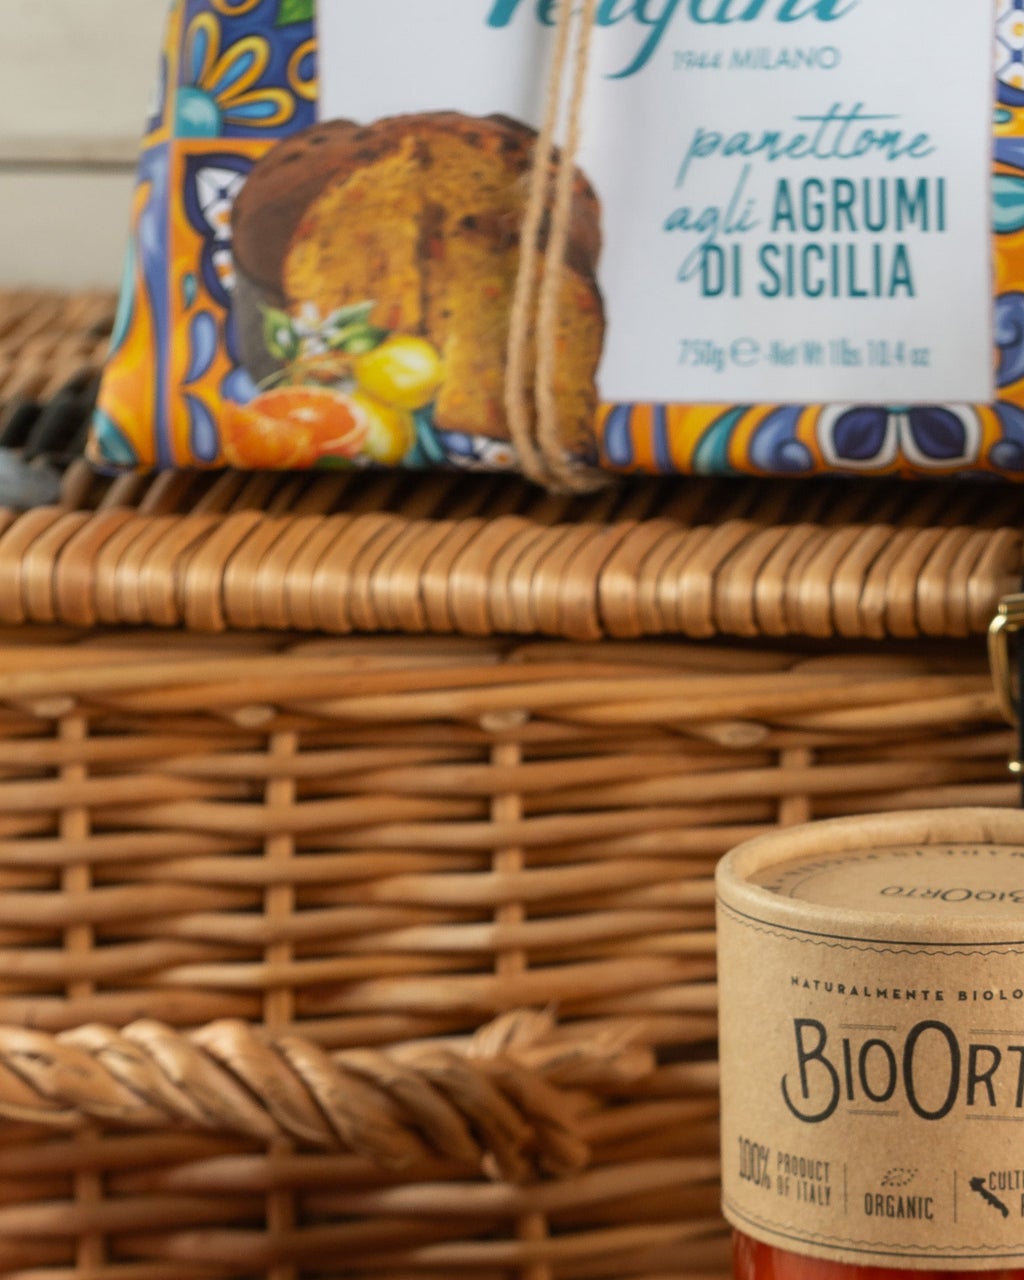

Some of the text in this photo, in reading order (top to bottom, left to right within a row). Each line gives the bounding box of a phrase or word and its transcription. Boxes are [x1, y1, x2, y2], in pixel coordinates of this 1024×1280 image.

[727, 47, 841, 70] MILANO
[674, 103, 937, 189] panettone
[663, 164, 946, 281] agli AGRUMI
[700, 244, 916, 298] DI SICILIA
[791, 975, 945, 1002] NATURALMENTE
[738, 1135, 771, 1191] 100%
[777, 1147, 830, 1184] PRODUCT
[796, 1181, 831, 1207] ITALY
[863, 1191, 935, 1220] ORGANIC
